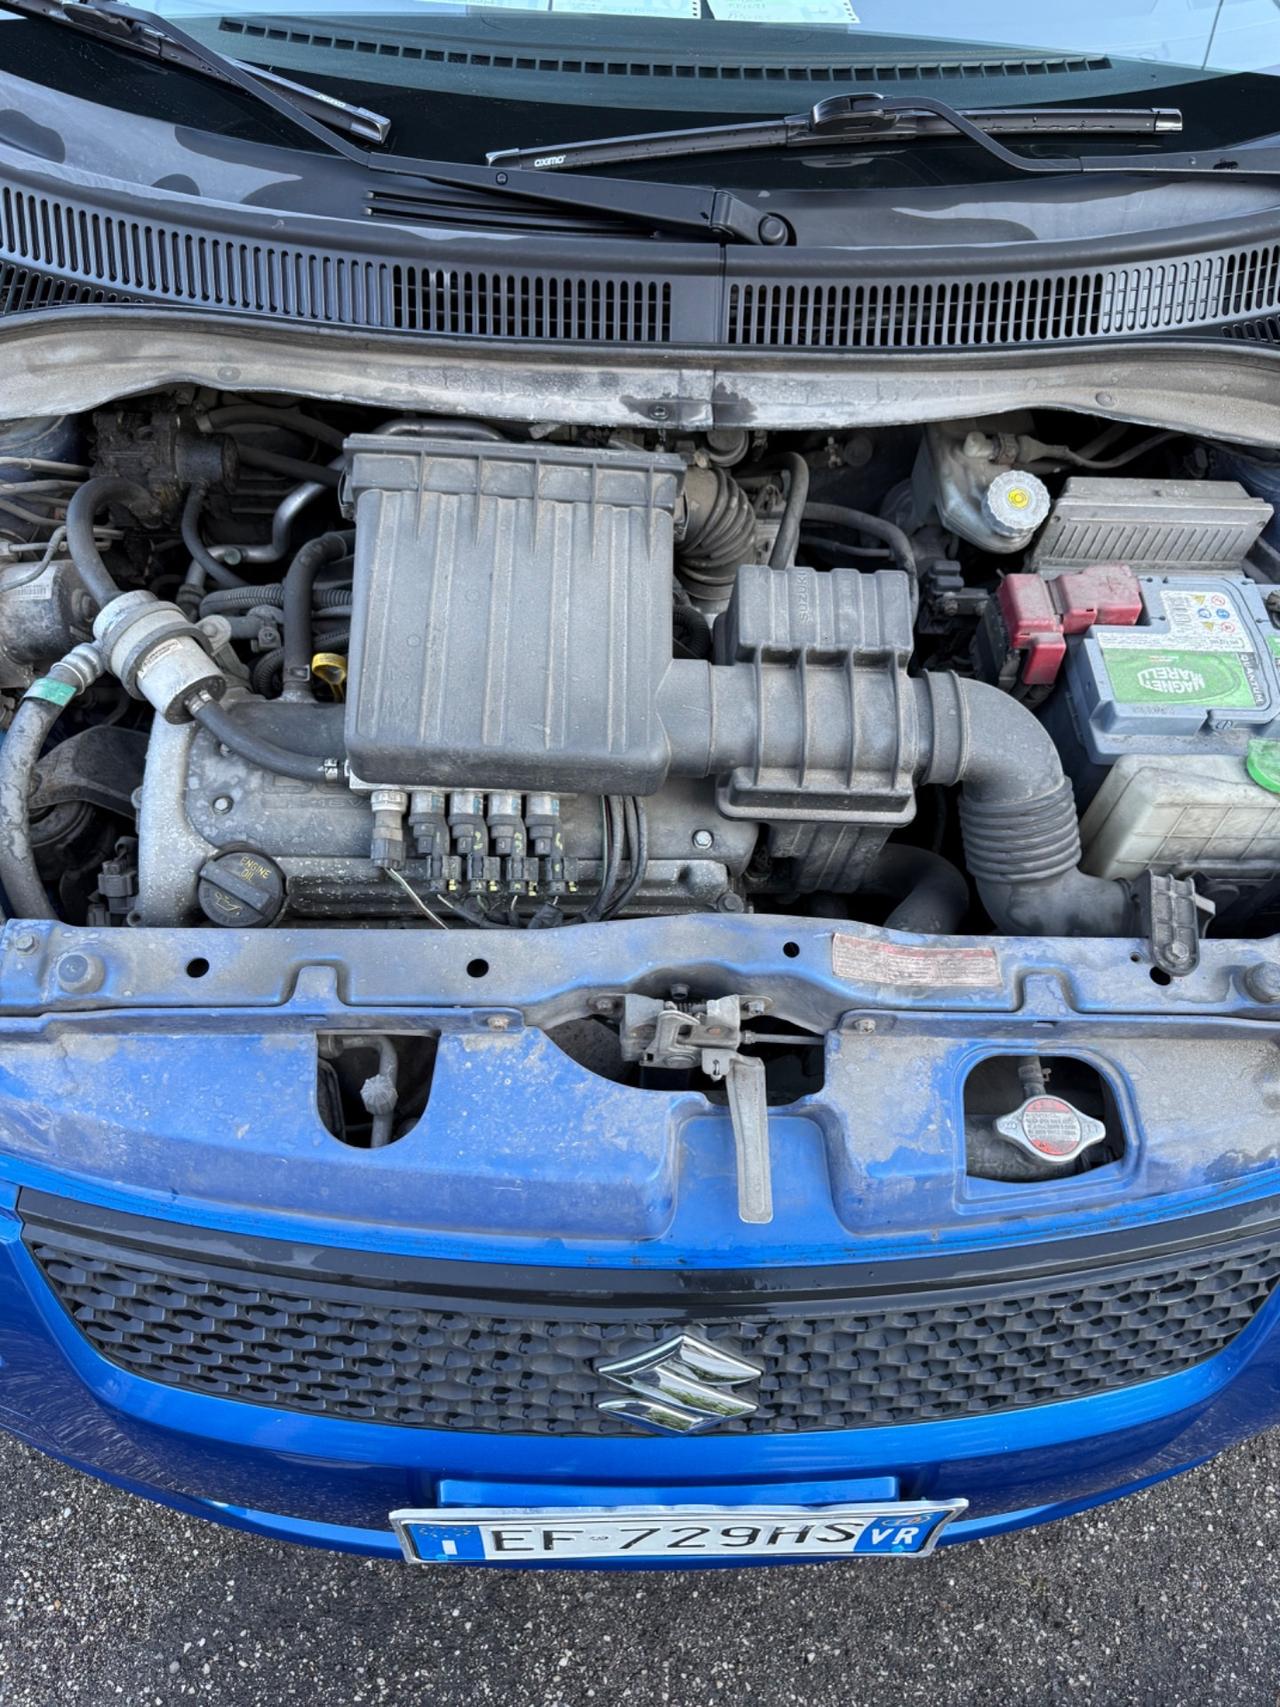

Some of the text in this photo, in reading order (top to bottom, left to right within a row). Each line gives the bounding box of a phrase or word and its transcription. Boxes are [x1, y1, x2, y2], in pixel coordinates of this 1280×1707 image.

[797, 571, 809, 624] SUZUKI
[1241, 654, 1264, 702] QUANTUM
[240, 856, 271, 879] ENGINE
[240, 868, 255, 881] OIL
[490, 1529, 585, 1551] EF
[619, 1521, 865, 1549] 729HS
[872, 1527, 919, 1544] VR
